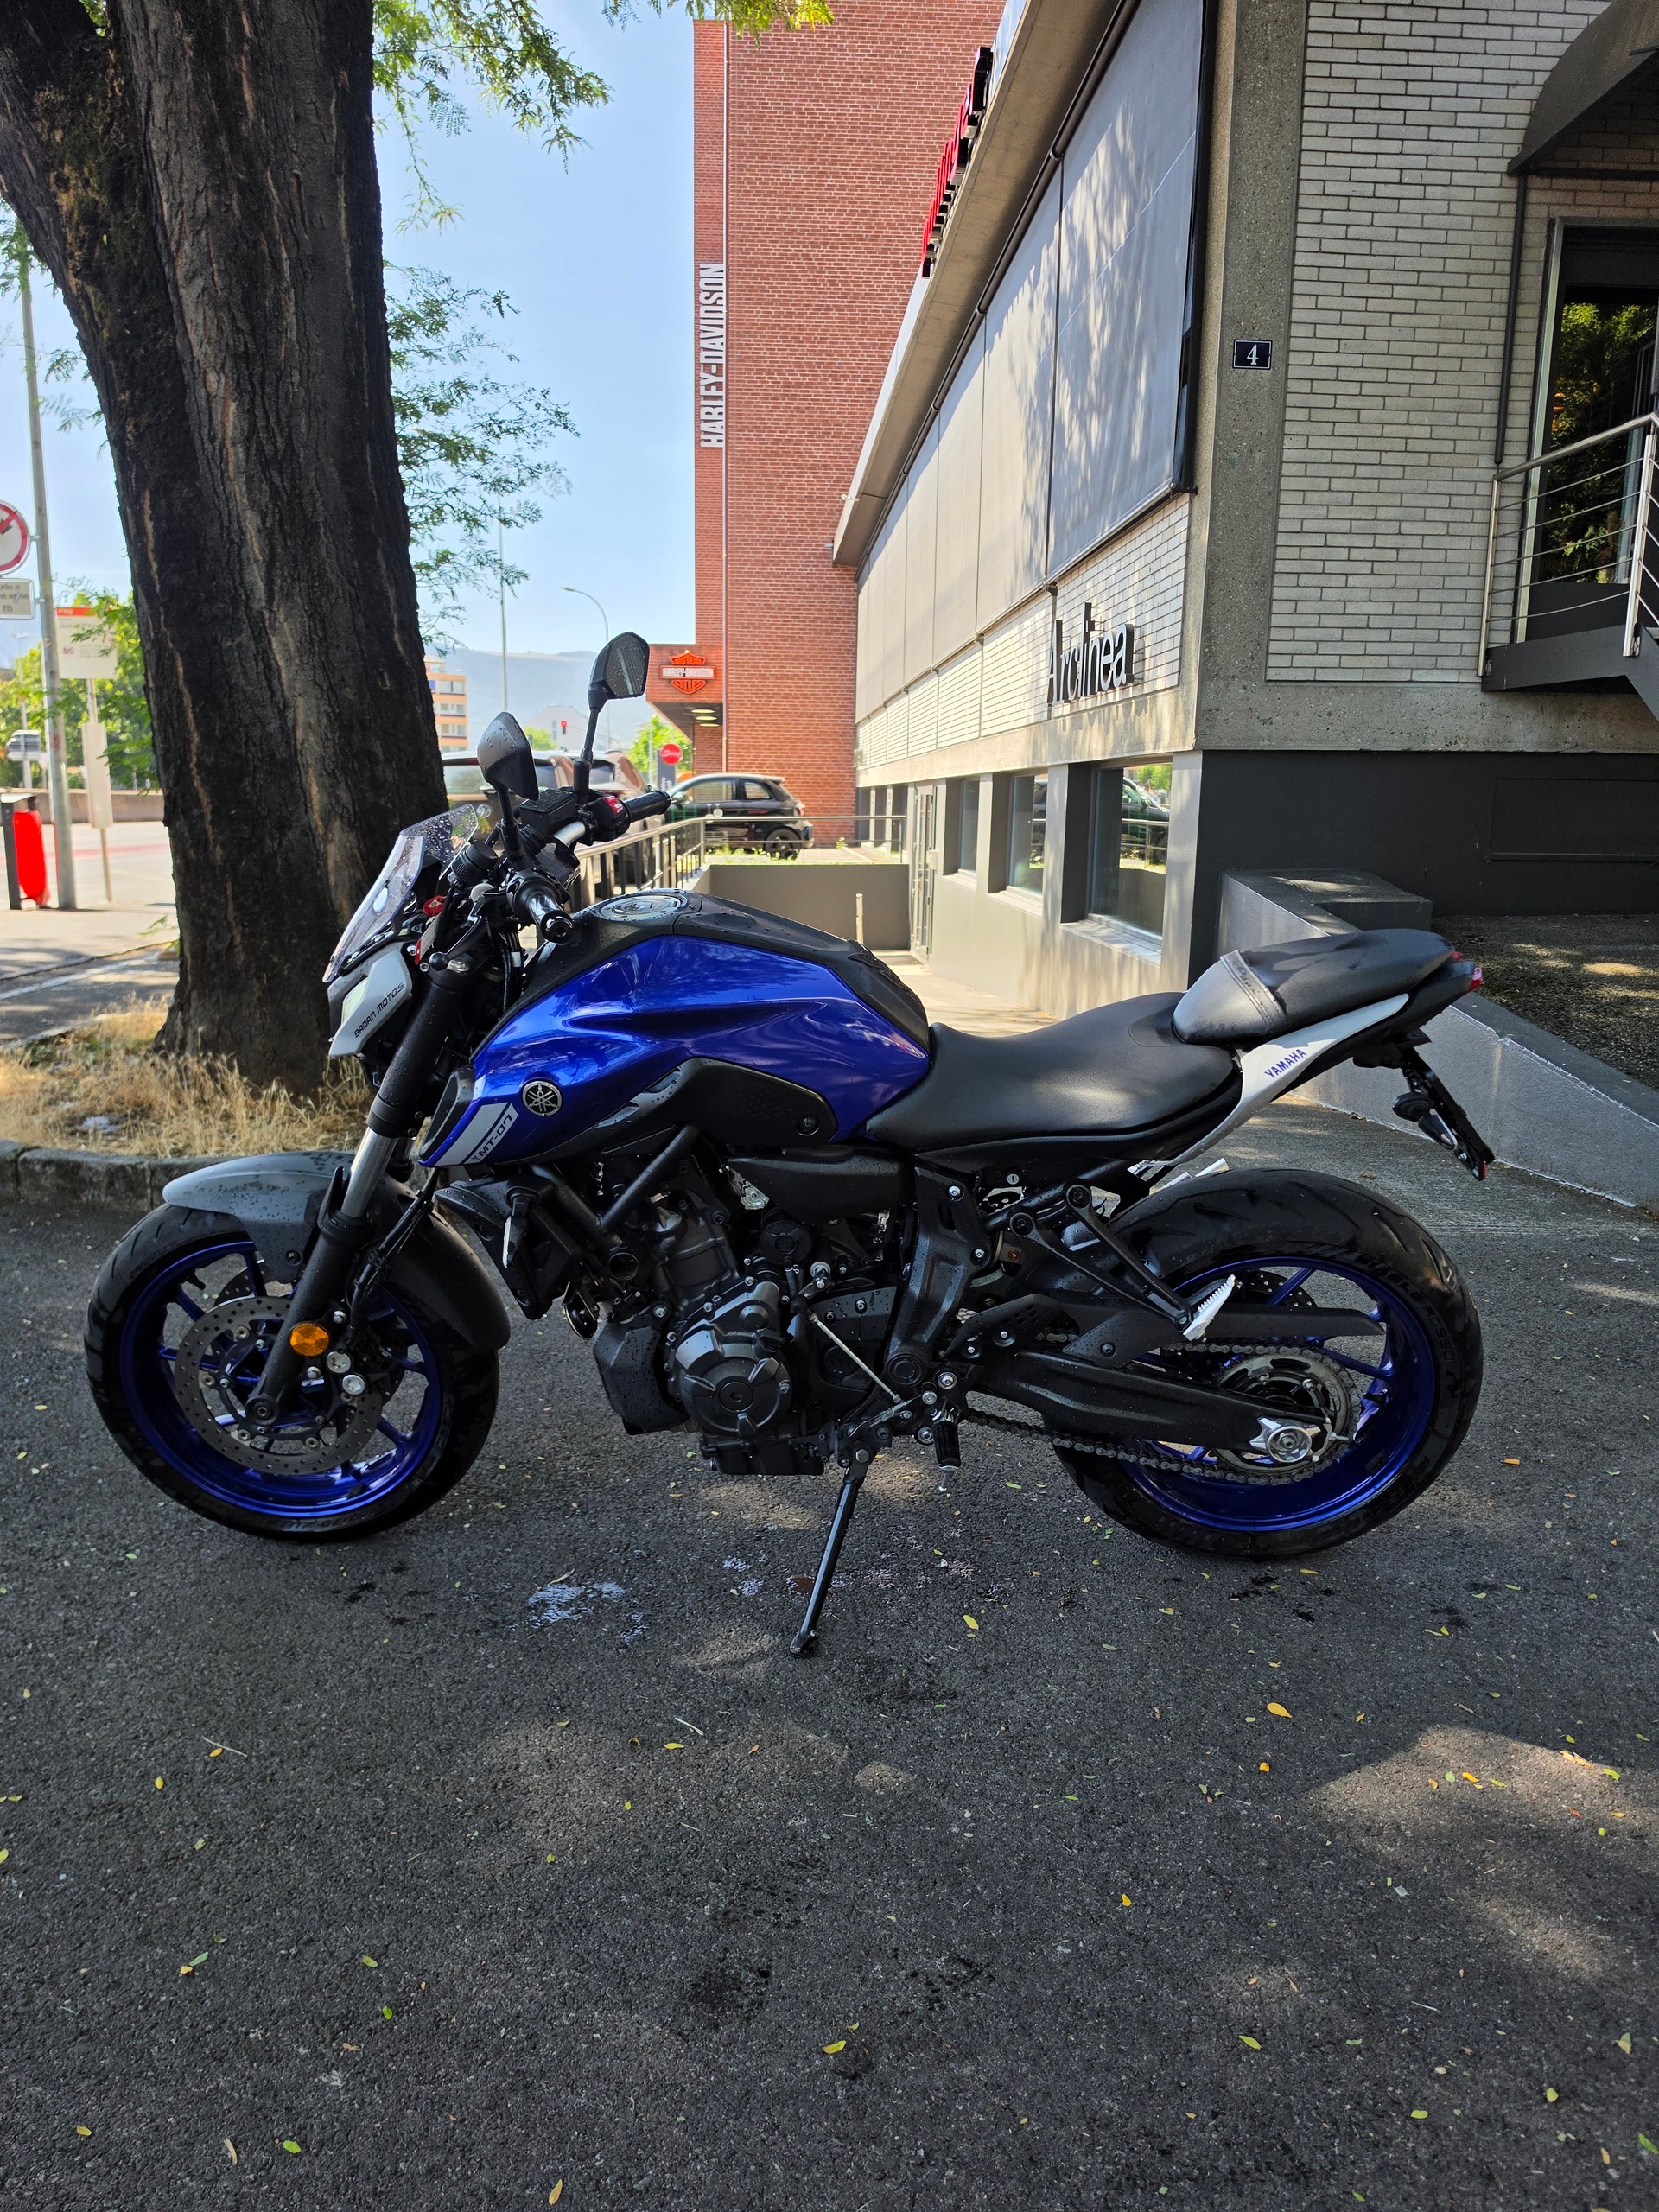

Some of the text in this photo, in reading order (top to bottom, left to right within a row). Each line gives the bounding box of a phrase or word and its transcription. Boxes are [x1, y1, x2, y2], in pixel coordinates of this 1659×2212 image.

[699, 264, 724, 447] HARLEY-DAVIDSON
[1247, 344, 1259, 365] 4
[1046, 602, 1134, 707] Arclinea
[353, 981, 404, 1039] BADAN MOTOS
[1264, 1049, 1306, 1078] YAMAHA
[478, 1114, 512, 1157] MT-07
